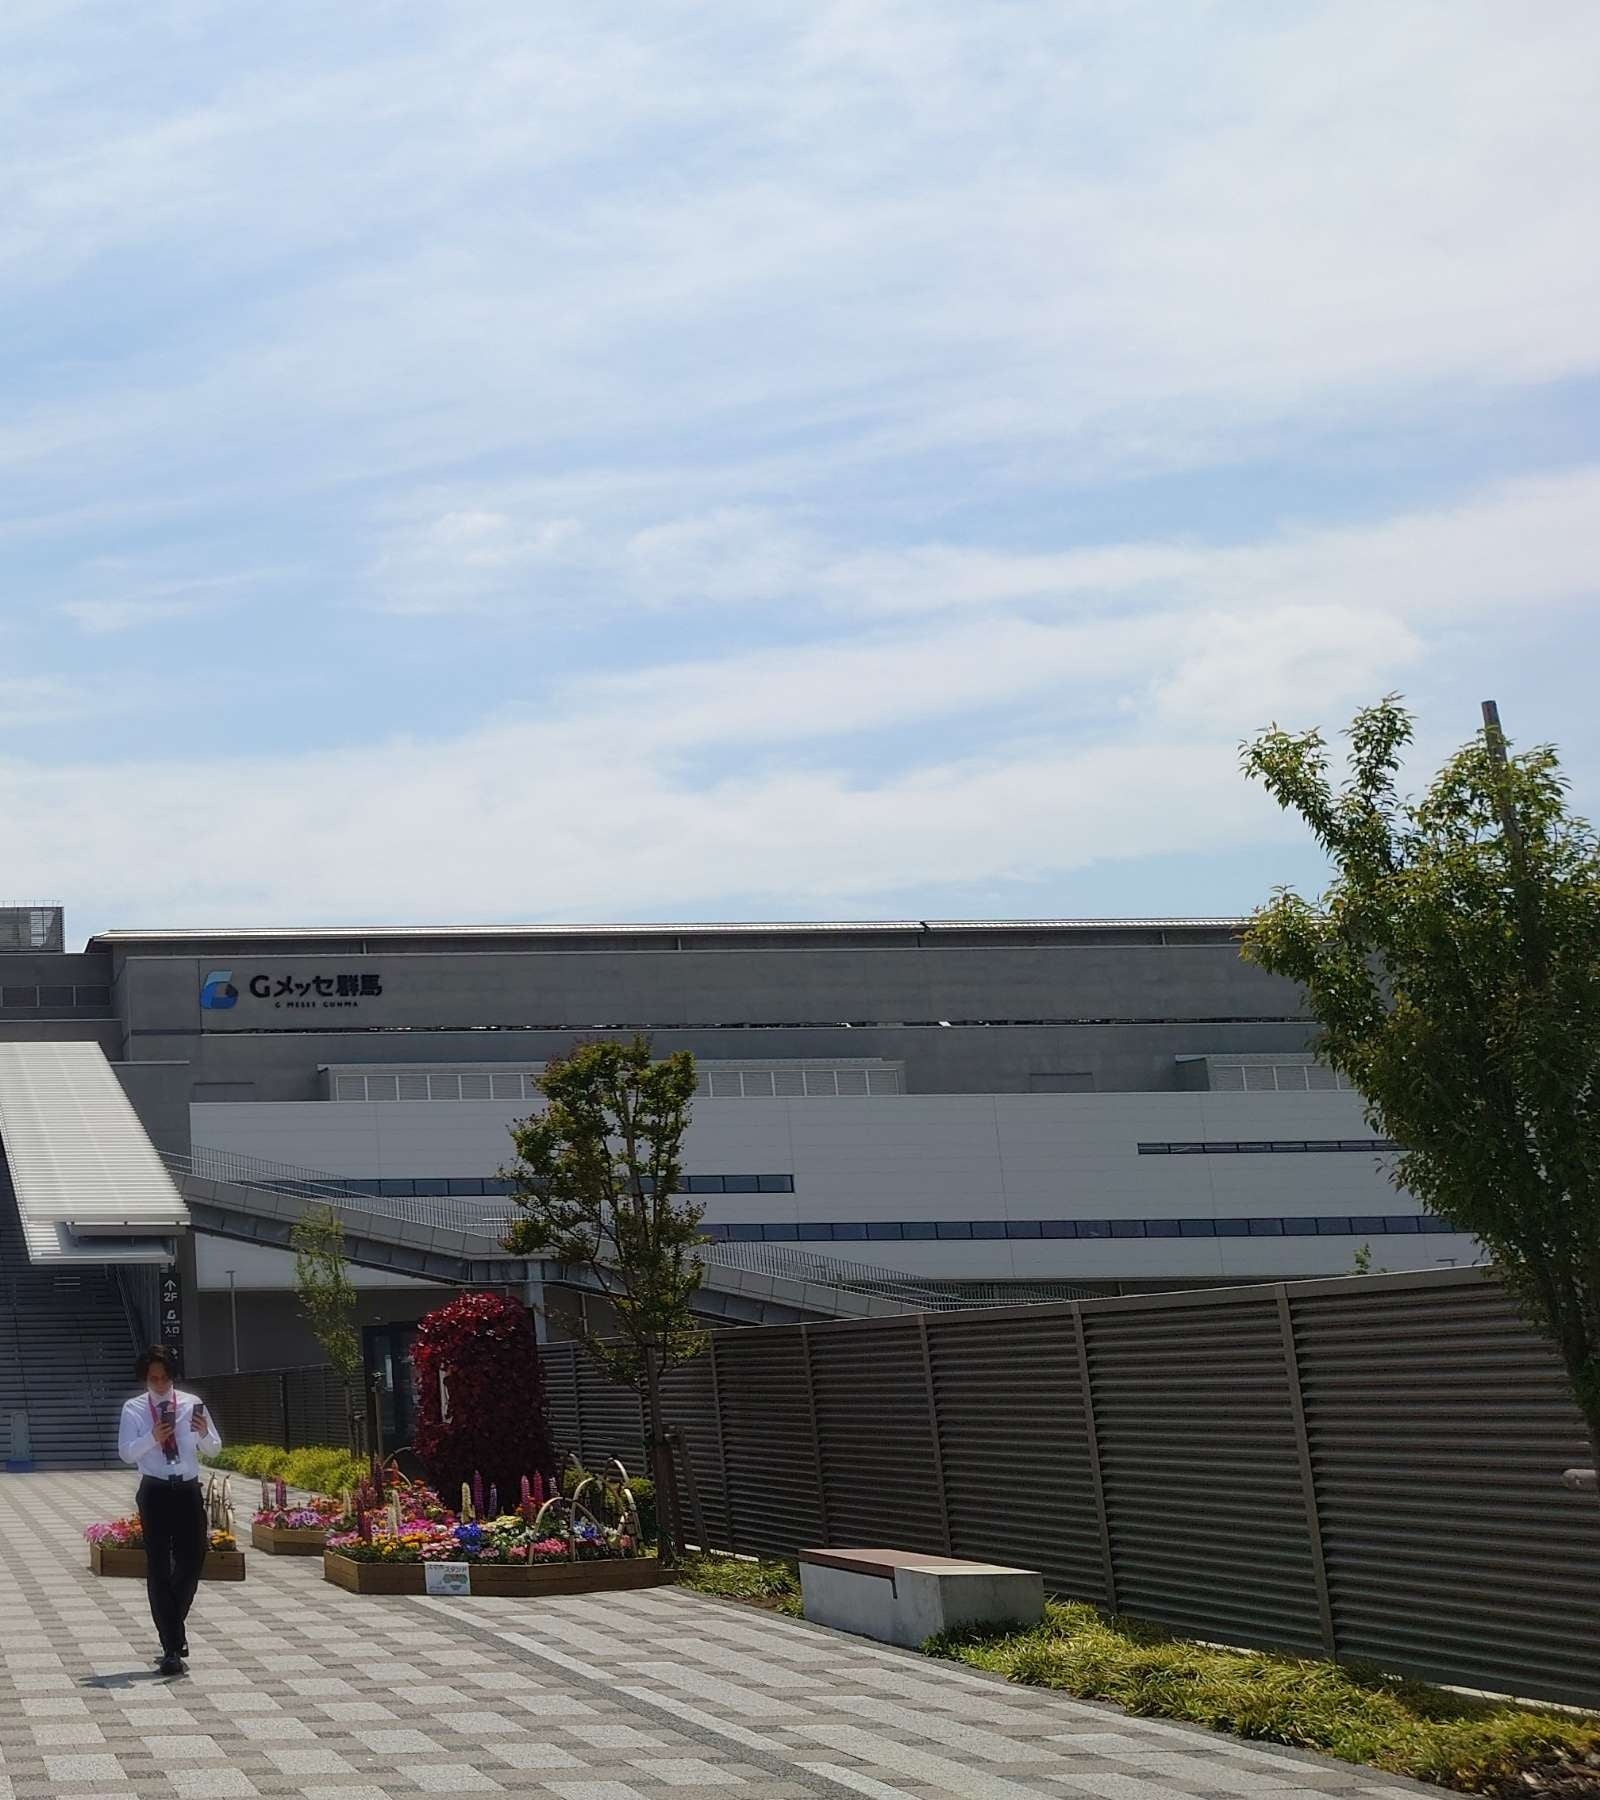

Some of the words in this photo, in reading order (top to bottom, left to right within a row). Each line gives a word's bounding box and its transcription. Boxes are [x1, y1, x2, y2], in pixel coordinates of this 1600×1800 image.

[249, 974, 383, 998] Gメッセ群馬
[163, 1292, 178, 1302] 2F
[164, 1326, 180, 1335] 入口
